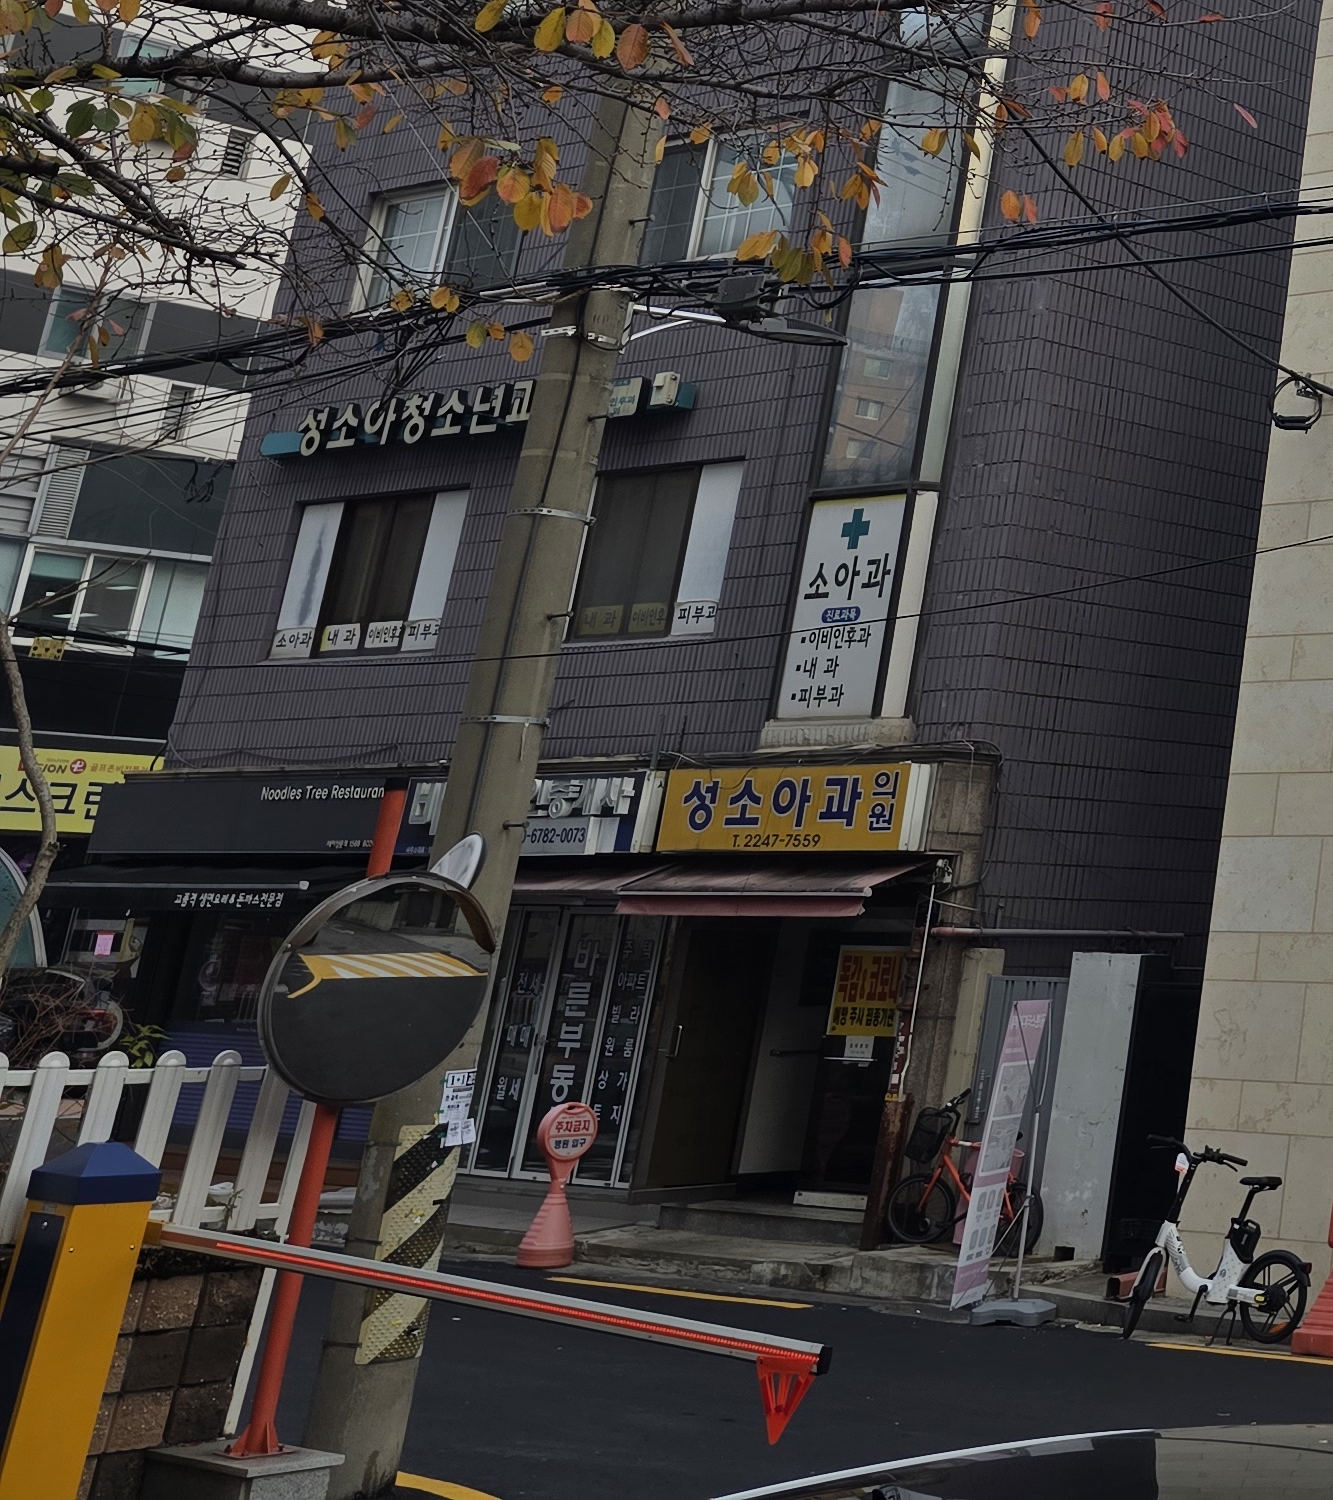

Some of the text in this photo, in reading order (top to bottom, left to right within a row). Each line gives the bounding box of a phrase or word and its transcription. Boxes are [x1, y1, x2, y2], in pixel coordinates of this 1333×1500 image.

[804, 553, 892, 600] 소아과
[631, 606, 666, 627] 이비인후
[825, 607, 859, 621] 진료과목
[276, 632, 313, 649] 소아과
[808, 625, 872, 650] 이비인후과
[797, 684, 845, 708] 피부과
[261, 785, 303, 801] Noodles
[305, 784, 329, 800] Tree
[683, 770, 900, 832] 성소아과 의원
[743, 833, 822, 848] 2247-7559
[617, 971, 647, 991] 아파트
[555, 1119, 591, 1134] 주차금지
